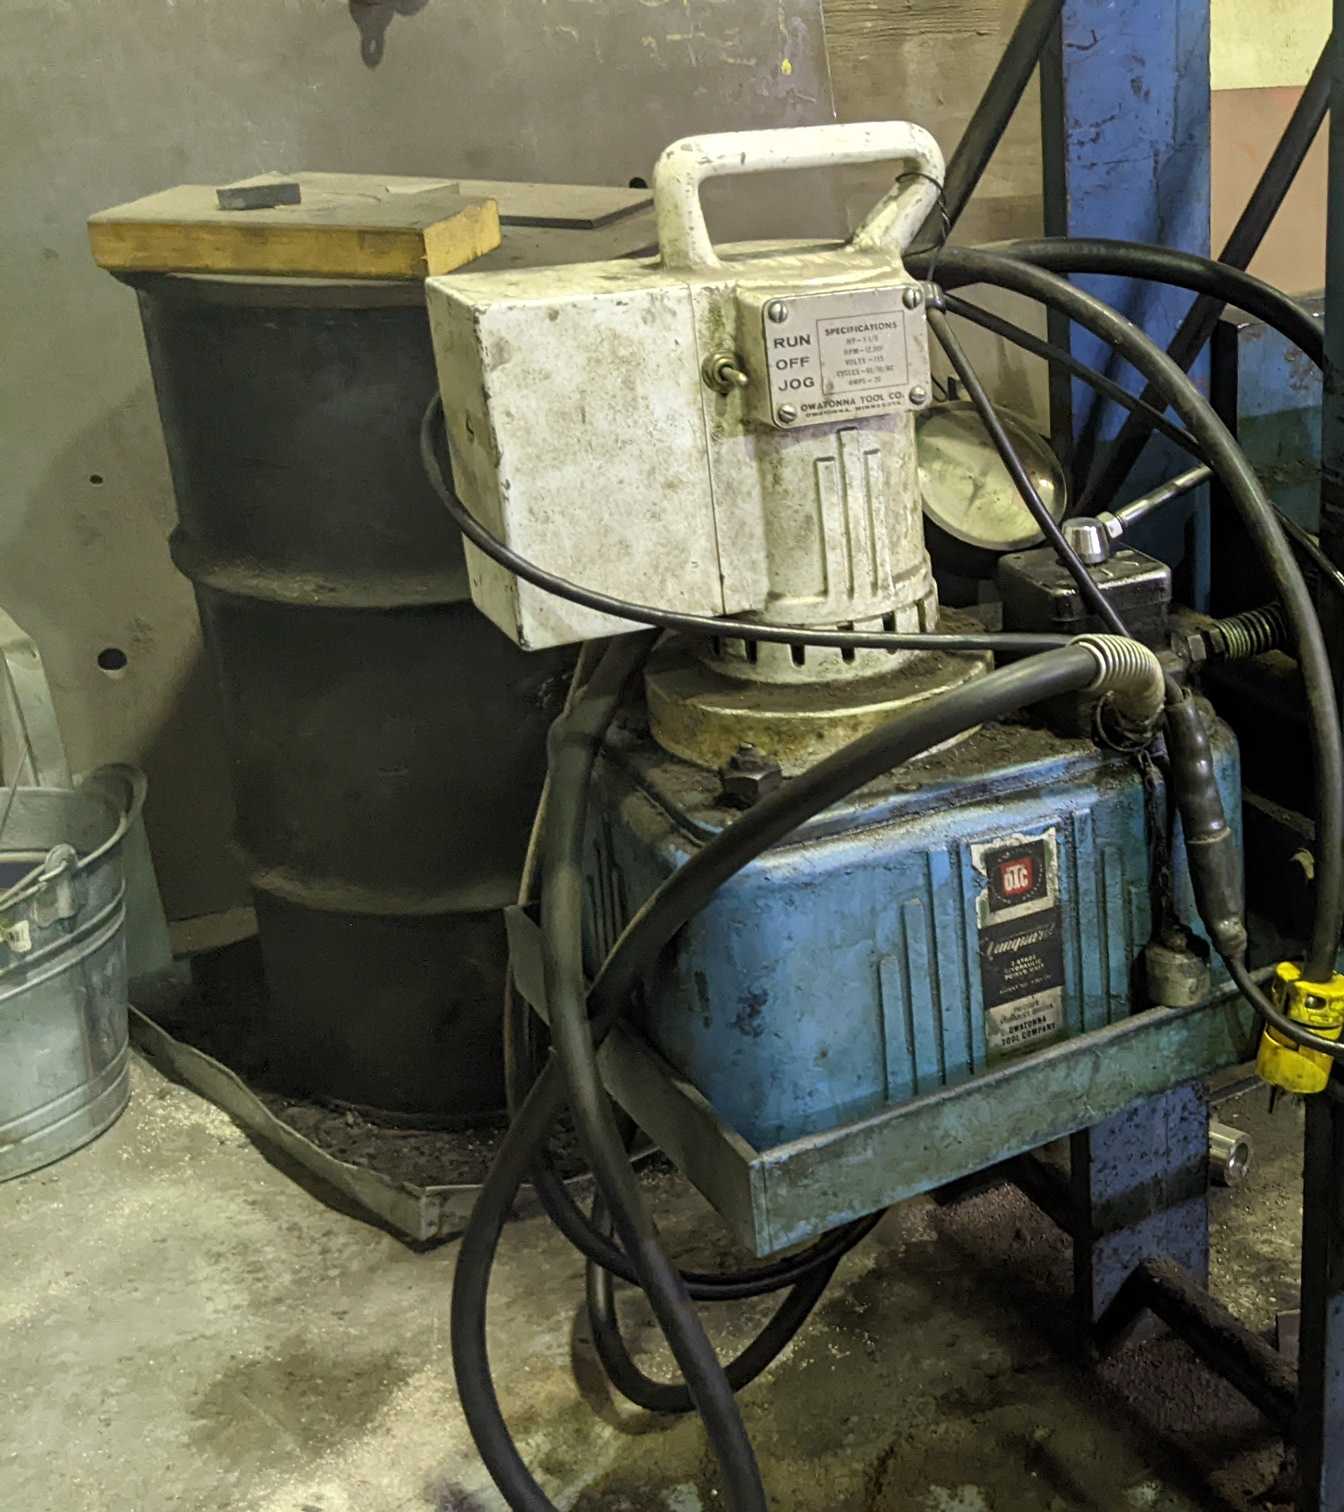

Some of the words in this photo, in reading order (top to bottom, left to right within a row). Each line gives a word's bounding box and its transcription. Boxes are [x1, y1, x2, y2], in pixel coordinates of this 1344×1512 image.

[825, 321, 898, 337] SPECIFICATIONS
[773, 334, 811, 349] RUN
[775, 356, 811, 371] OFF
[778, 376, 815, 392] JOG
[800, 399, 856, 412] OWATONNA
[860, 393, 885, 405] TOOL
[889, 391, 905, 400] CO.
[1021, 1022, 1057, 1041] COMPANY
